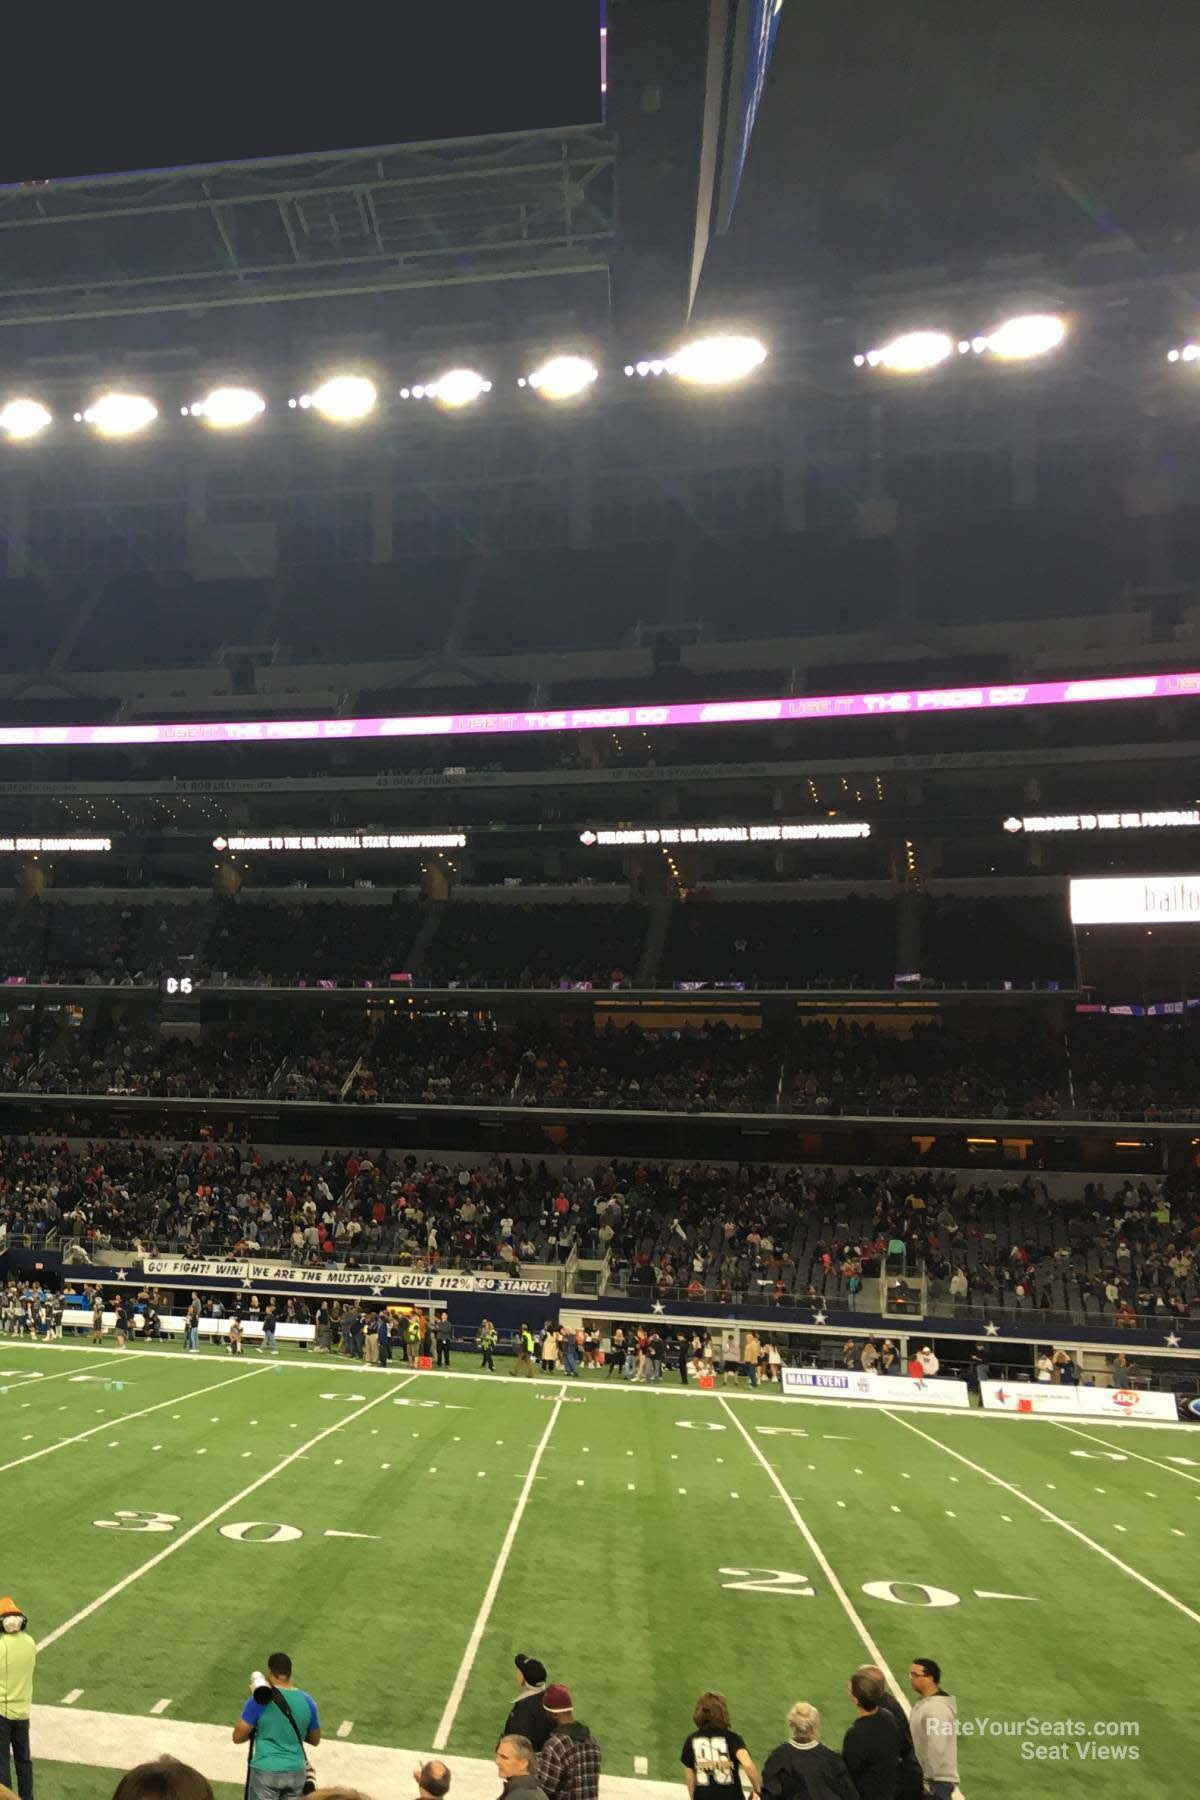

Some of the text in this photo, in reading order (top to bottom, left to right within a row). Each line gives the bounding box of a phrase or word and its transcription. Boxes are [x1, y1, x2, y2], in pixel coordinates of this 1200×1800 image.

[147, 1261, 243, 1275] GO! FIGHT! WIN!
[252, 1265, 392, 1284] WE ARE THE MUSTANGS!
[401, 1275, 473, 1289] GIVE 112%
[478, 1279, 550, 1292] GO STANGS!
[786, 1374, 813, 1387] MAIN
[816, 1375, 847, 1388] EVENT
